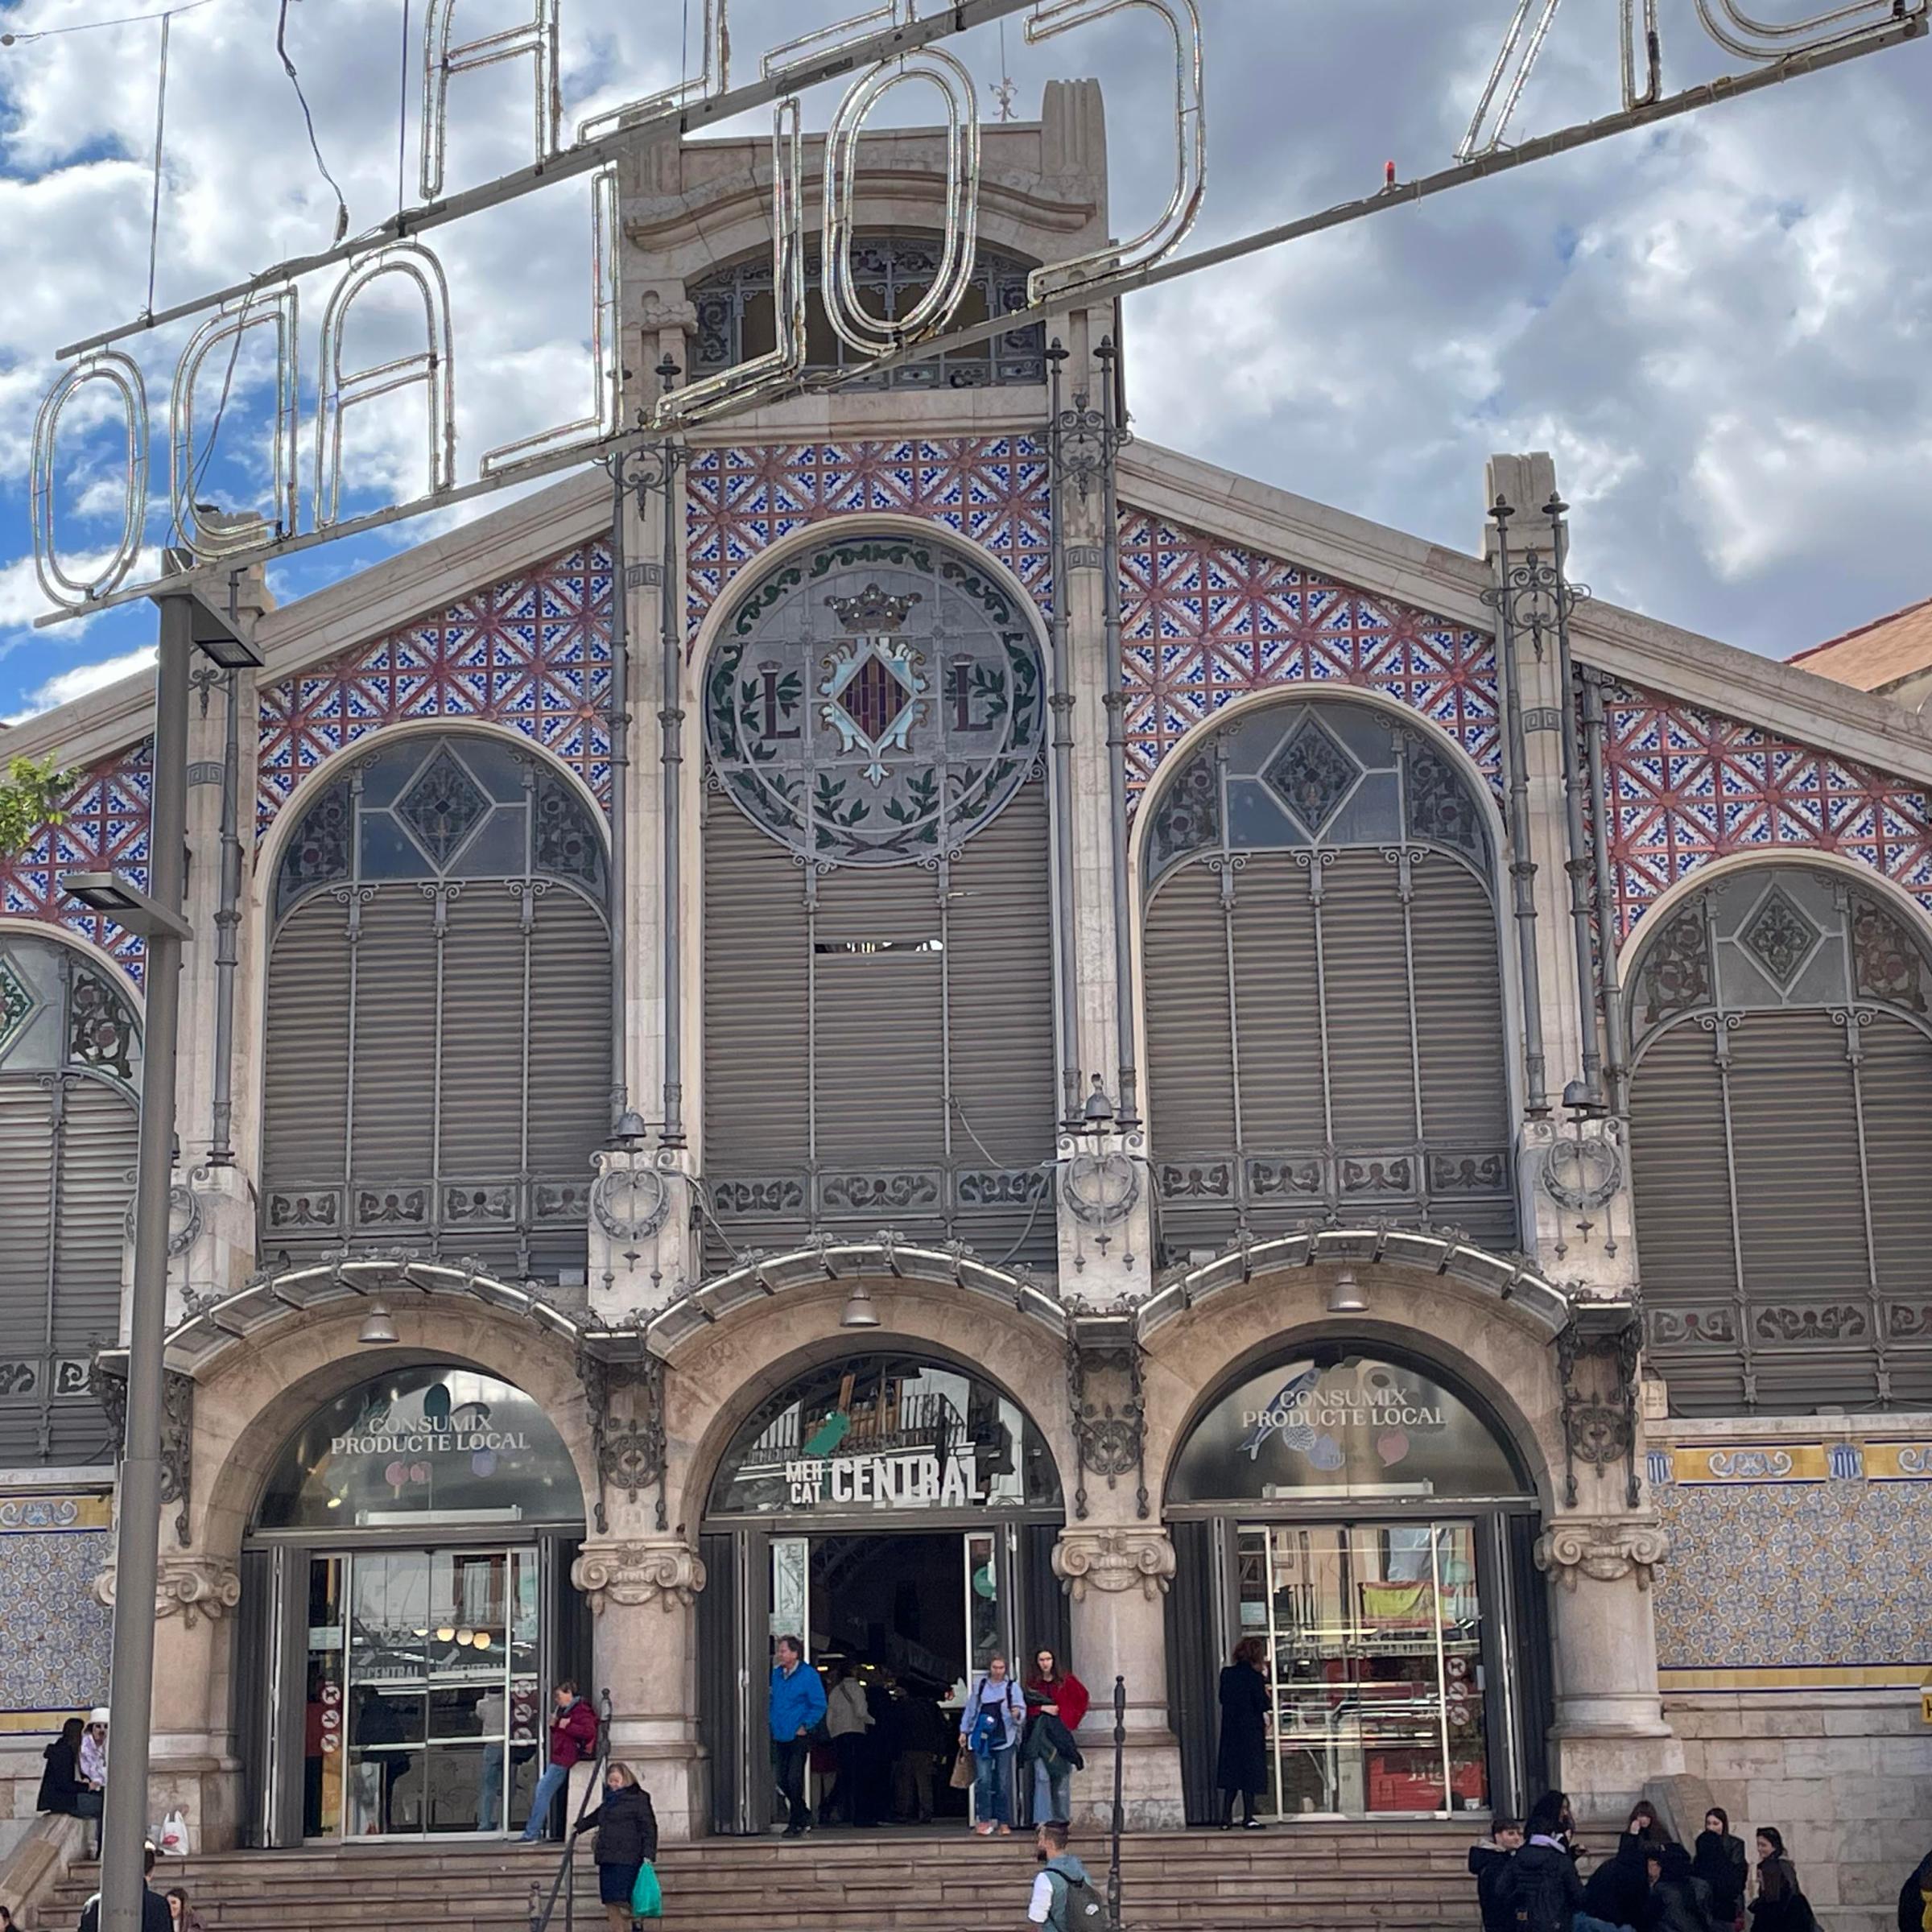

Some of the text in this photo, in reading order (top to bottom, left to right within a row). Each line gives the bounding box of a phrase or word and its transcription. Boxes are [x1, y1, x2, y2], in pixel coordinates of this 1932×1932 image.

[1279, 1388, 1409, 1409] CONSUMIX
[368, 1414, 493, 1435] CONSUMIX
[1242, 1406, 1448, 1428] PRODUCTE LOCAL
[330, 1432, 531, 1455] PRODUCTE LOCAL
[786, 1460, 823, 1483] MER
[831, 1454, 985, 1504] CENTRAL
[791, 1482, 823, 1505] CAT
